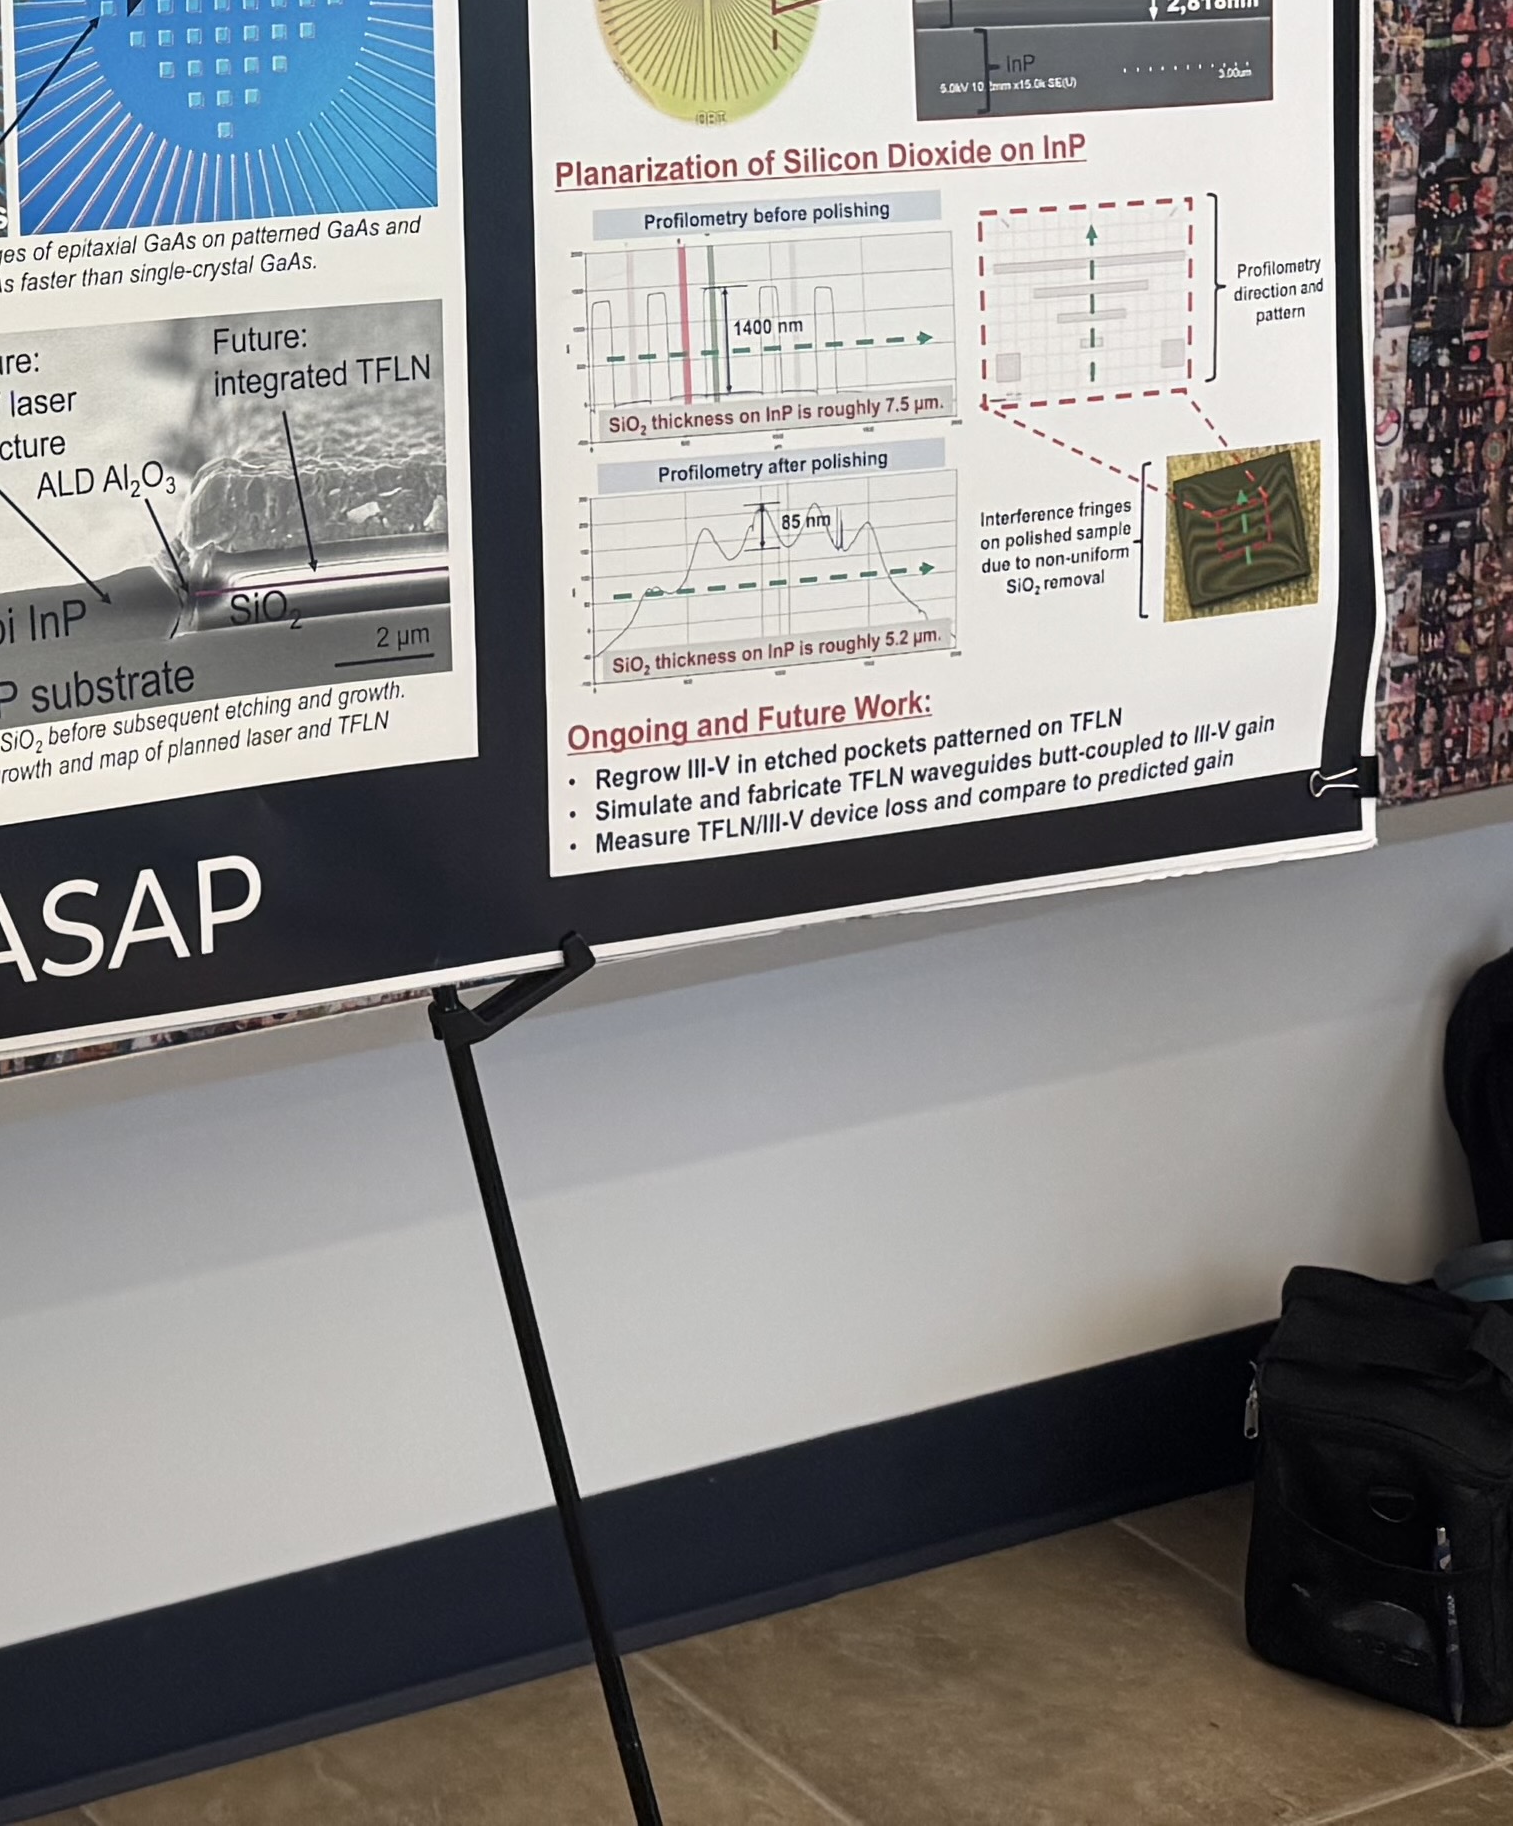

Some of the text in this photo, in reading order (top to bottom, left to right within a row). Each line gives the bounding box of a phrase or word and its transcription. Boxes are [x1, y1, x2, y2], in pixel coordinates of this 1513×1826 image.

[555, 132, 1086, 189] Planarization of Silicon Dioxide on InP
[644, 201, 890, 231] Profilometry before polishing
[567, 689, 931, 755] Ongoing and Future Work:
